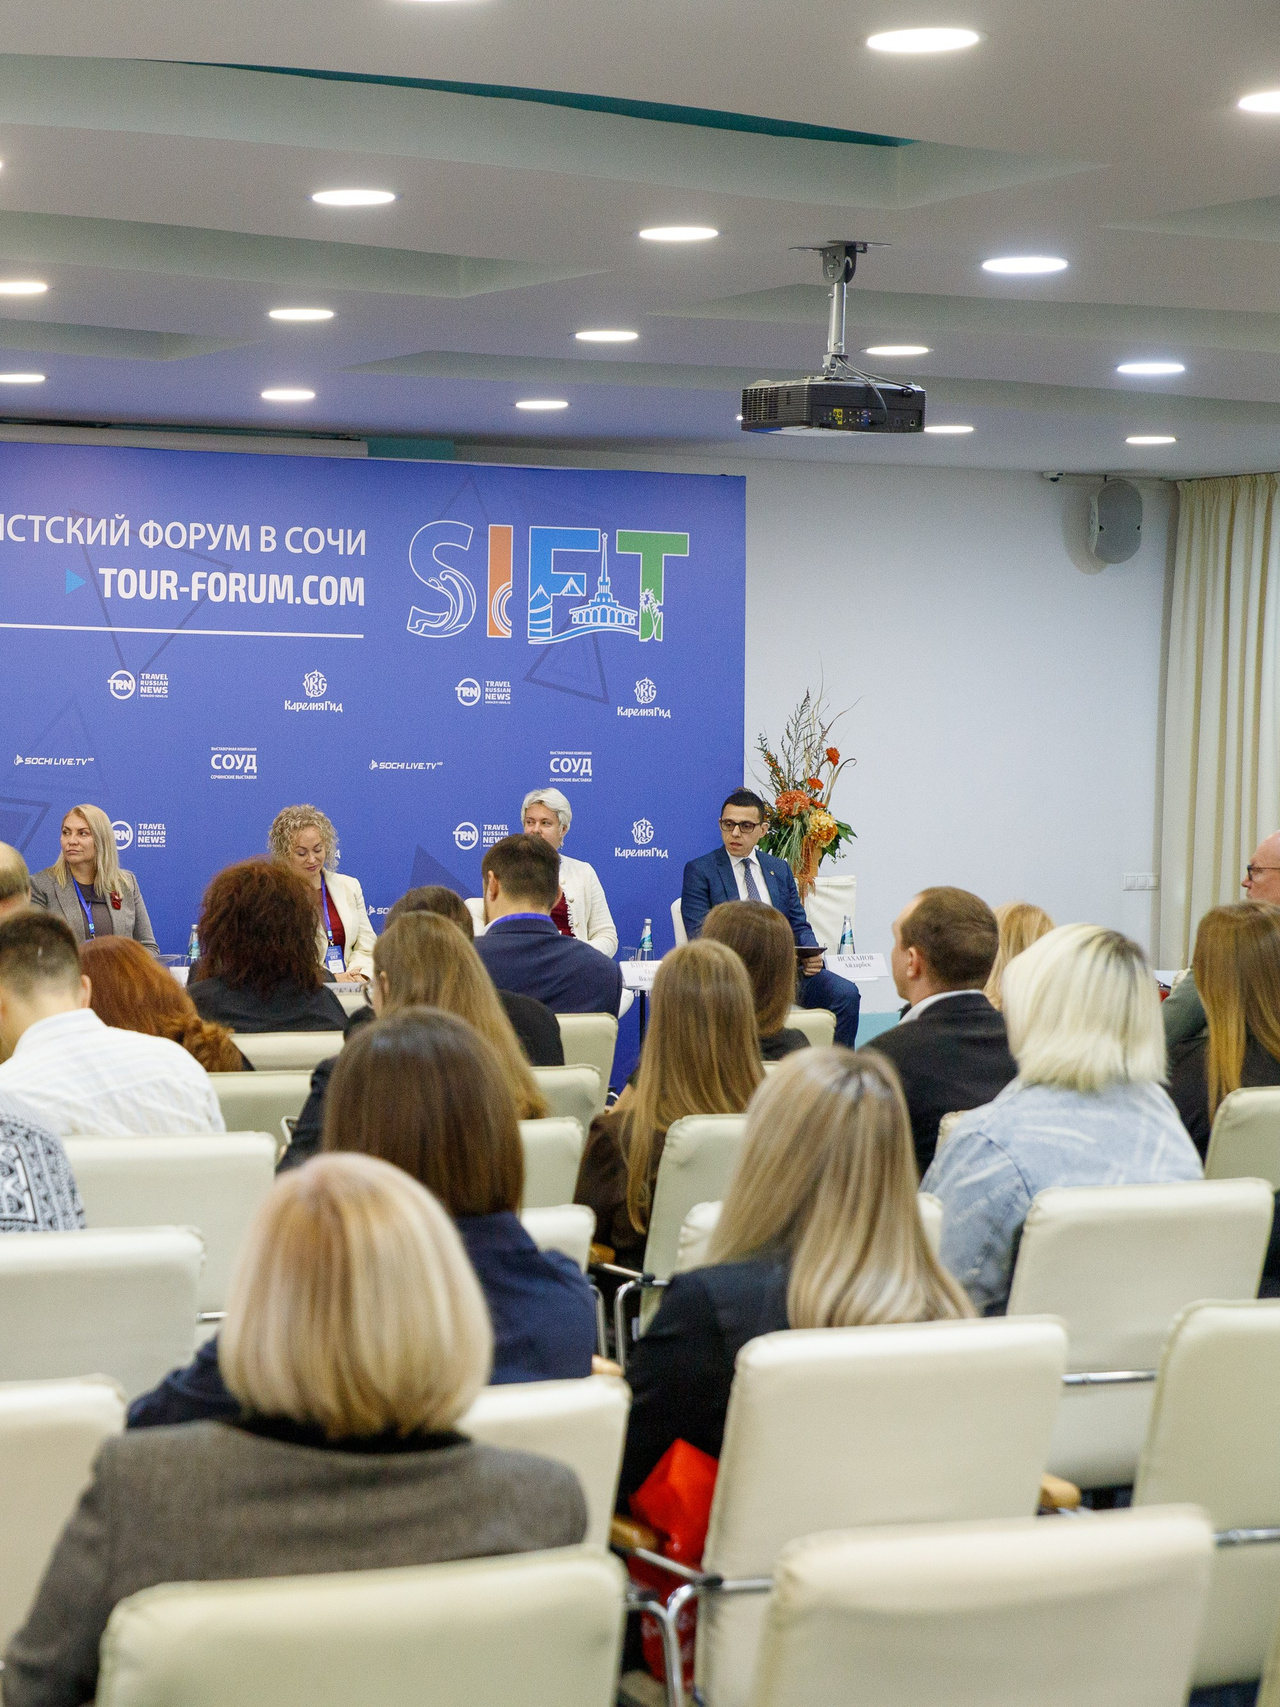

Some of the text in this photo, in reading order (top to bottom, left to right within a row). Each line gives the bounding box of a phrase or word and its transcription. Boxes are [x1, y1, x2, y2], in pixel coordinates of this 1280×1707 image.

[138, 519, 251, 552] ФОРУМ
[259, 525, 277, 553] В
[284, 526, 366, 556] СОЧИ
[98, 567, 365, 607] TOUR-FORUM.COM
[140, 686, 168, 694] NEWS
[284, 700, 344, 713] КарелияГид
[617, 706, 672, 719] КарелияГид
[24, 757, 53, 765] SOCHI
[210, 753, 258, 773] СОУД
[378, 762, 405, 770] SOCHI
[549, 757, 593, 776] СОУД
[482, 836, 506, 844] NEW
[614, 847, 669, 860] КарелияГид
